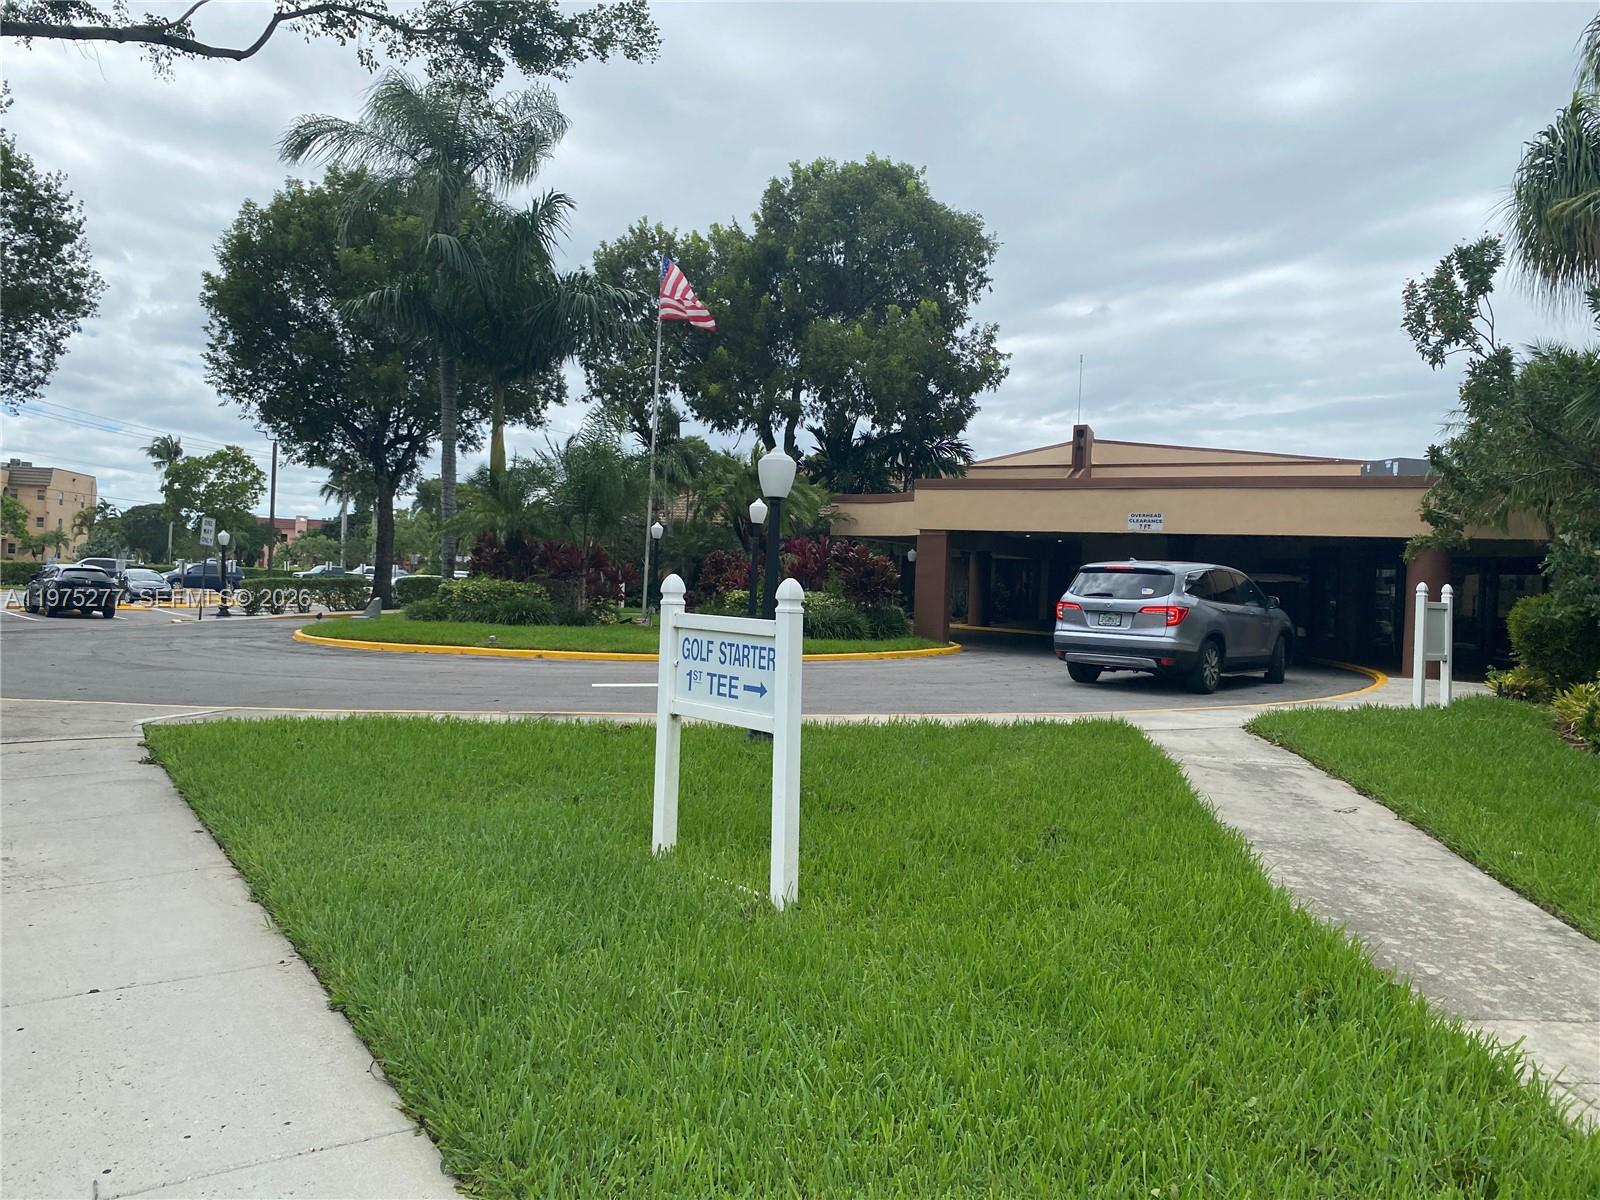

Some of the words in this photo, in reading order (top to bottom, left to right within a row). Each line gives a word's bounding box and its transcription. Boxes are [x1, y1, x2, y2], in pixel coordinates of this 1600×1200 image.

[682, 637, 715, 662] GOLF
[718, 641, 776, 672] STARTER
[686, 669, 703, 692] 1ST
[706, 672, 740, 700] TEE
